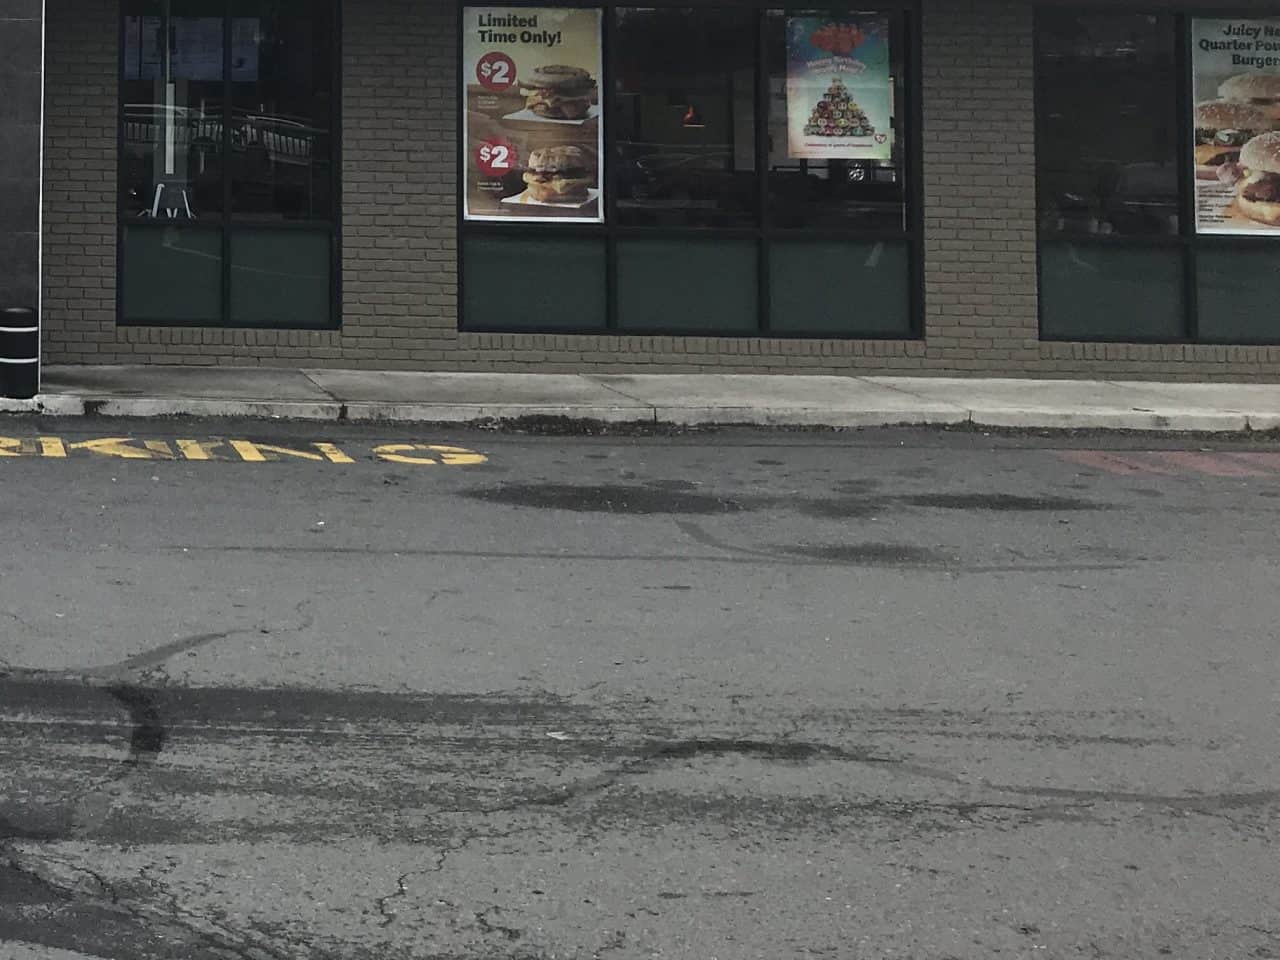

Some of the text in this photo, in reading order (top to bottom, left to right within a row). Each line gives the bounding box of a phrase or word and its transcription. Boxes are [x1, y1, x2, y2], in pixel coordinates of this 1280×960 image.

[478, 14, 537, 28] Limited
[478, 30, 562, 47] Time Only!
[1223, 24, 1261, 39] Juicy
[1199, 38, 1253, 51] Quarter
[480, 60, 510, 84] $2
[479, 145, 509, 169] $2
